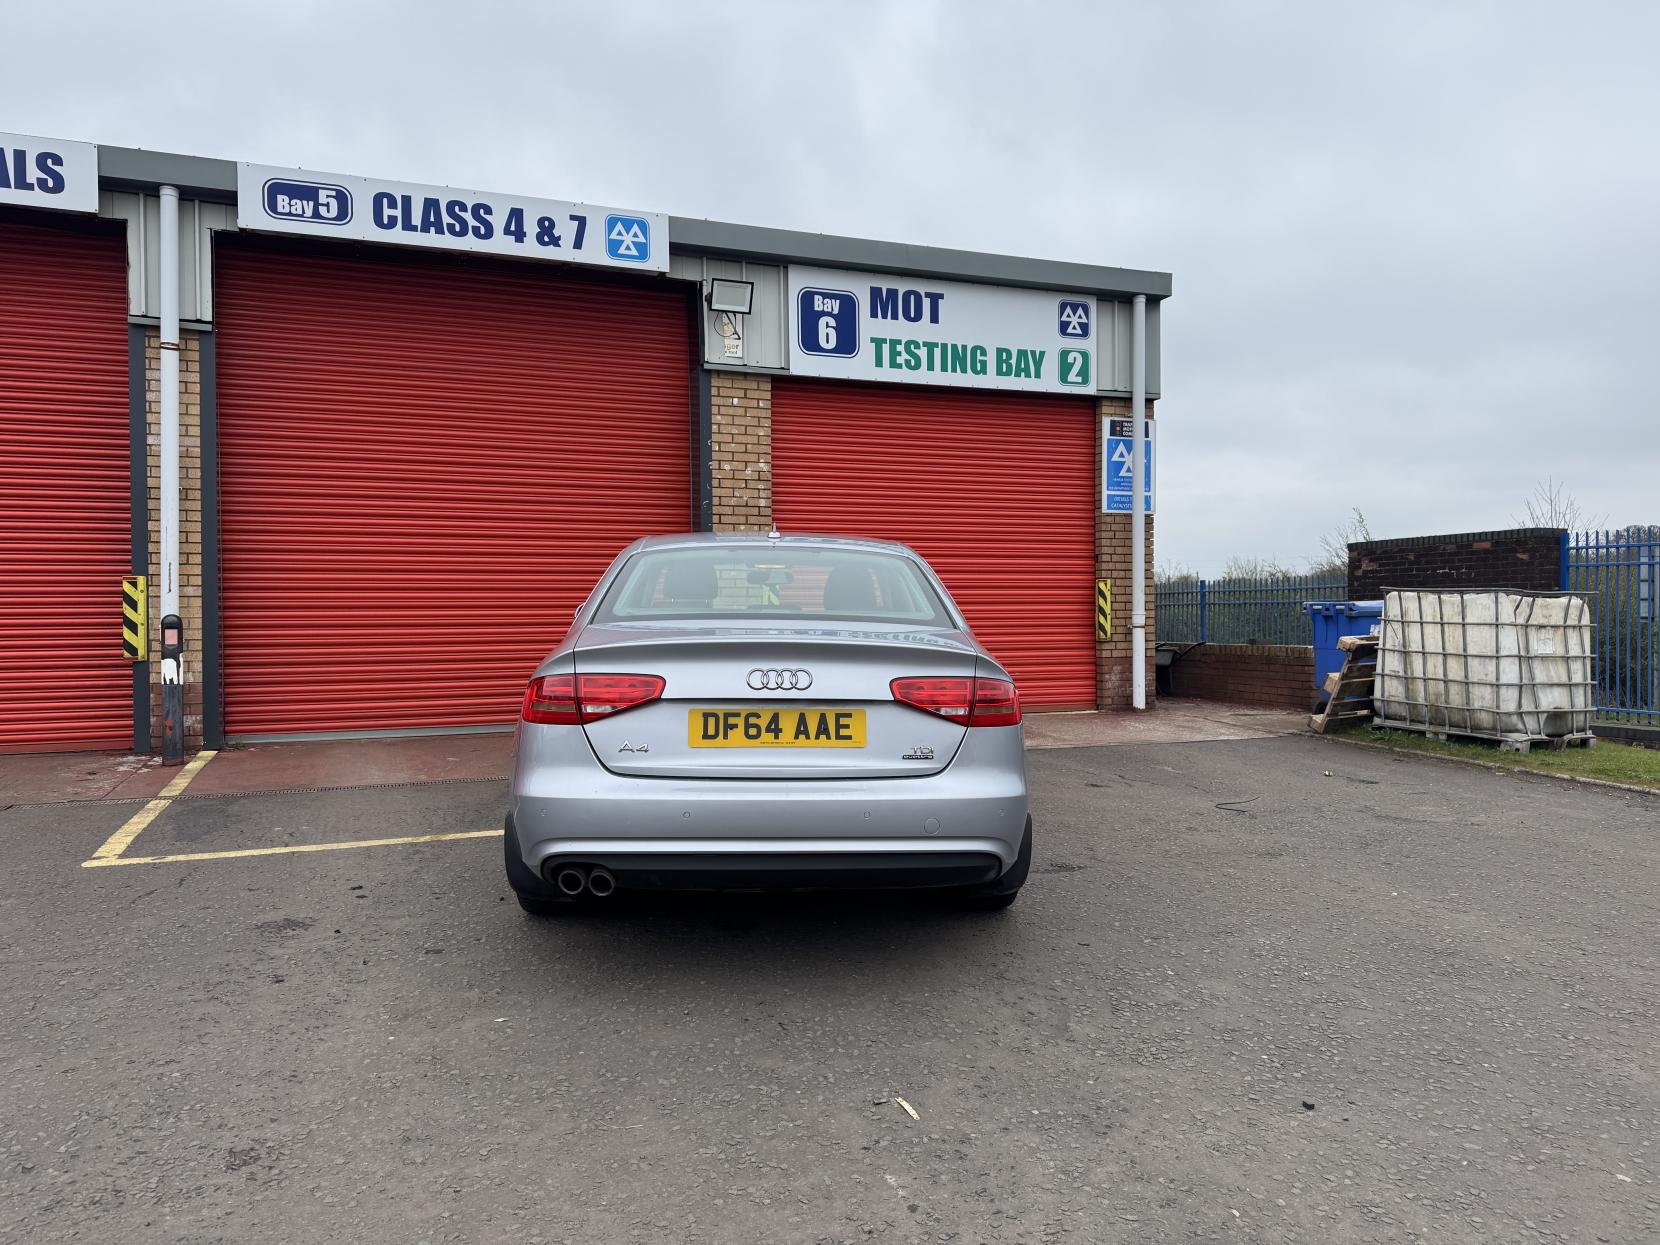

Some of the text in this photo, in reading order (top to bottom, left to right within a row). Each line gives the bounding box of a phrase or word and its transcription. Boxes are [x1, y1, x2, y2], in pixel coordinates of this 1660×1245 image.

[276, 189, 339, 219] Bay 5
[372, 191, 587, 250] CLASS 4 & 7
[814, 294, 840, 315] Bay
[869, 286, 944, 325] MOT
[818, 315, 837, 350] 6
[869, 336, 1046, 379] TESTING BAY
[1067, 351, 1083, 383] 2
[701, 712, 853, 741] DF64 AAE
[617, 740, 649, 753] A4
